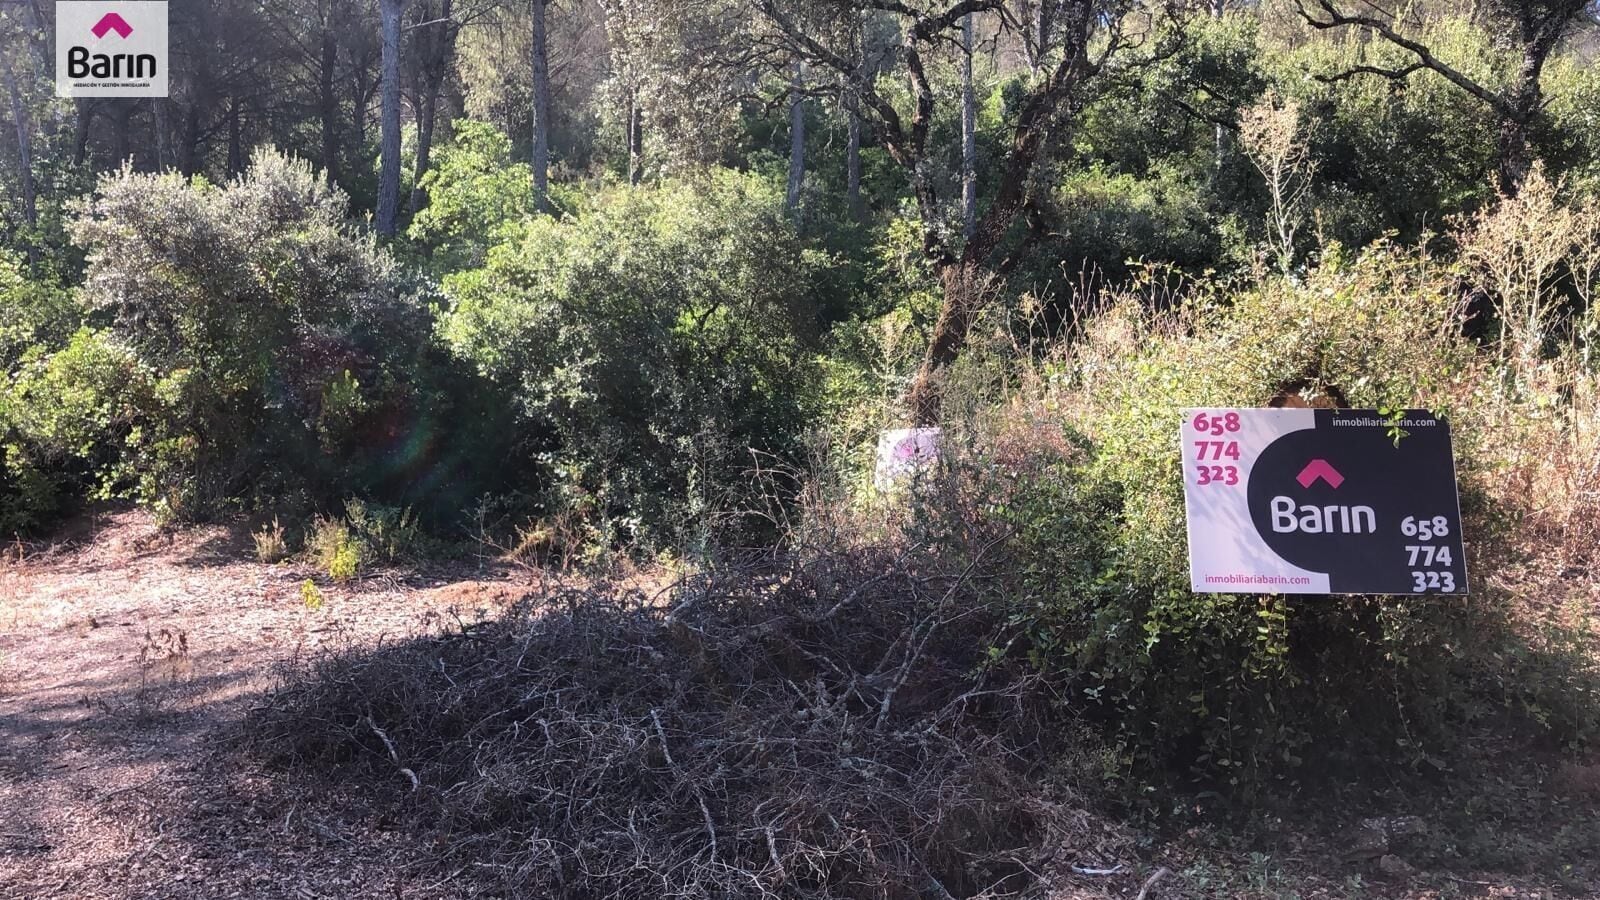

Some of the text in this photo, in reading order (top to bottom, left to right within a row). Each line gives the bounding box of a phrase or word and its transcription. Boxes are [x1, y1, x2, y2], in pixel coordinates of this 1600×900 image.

[1193, 412, 1241, 436] 658
[1332, 416, 1436, 427] inmobiliariaarin.com
[1194, 441, 1241, 461] 774
[1196, 466, 1239, 486] 323
[1270, 496, 1377, 534] Barin
[1400, 515, 1449, 541] 658
[1405, 545, 1452, 567] 774
[1205, 573, 1310, 586] inmobiliariabarin.com
[1412, 571, 1456, 593] 323
